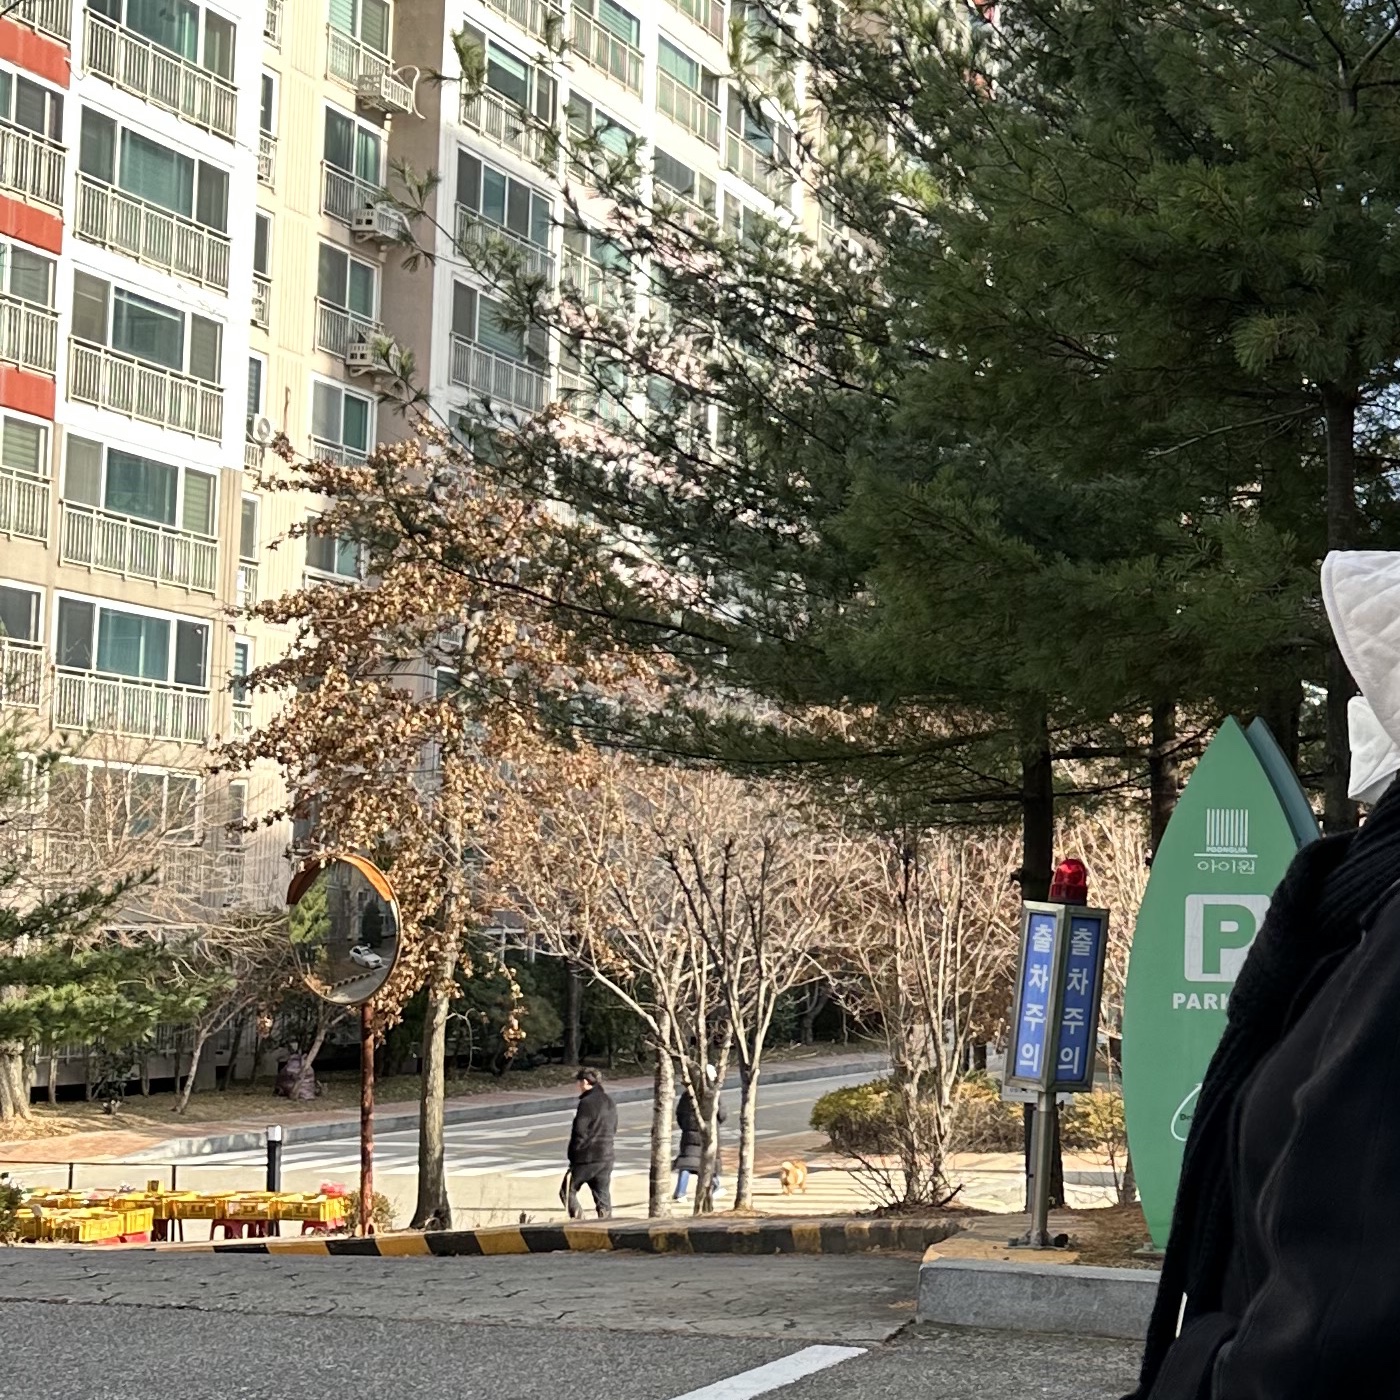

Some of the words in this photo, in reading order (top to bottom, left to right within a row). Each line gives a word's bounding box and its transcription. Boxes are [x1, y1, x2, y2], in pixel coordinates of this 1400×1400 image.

[1197, 859, 1256, 875] 아이원
[1202, 904, 1257, 974] P
[1019, 924, 1053, 1073] 출차주의
[1057, 927, 1093, 1075] 출차주의
